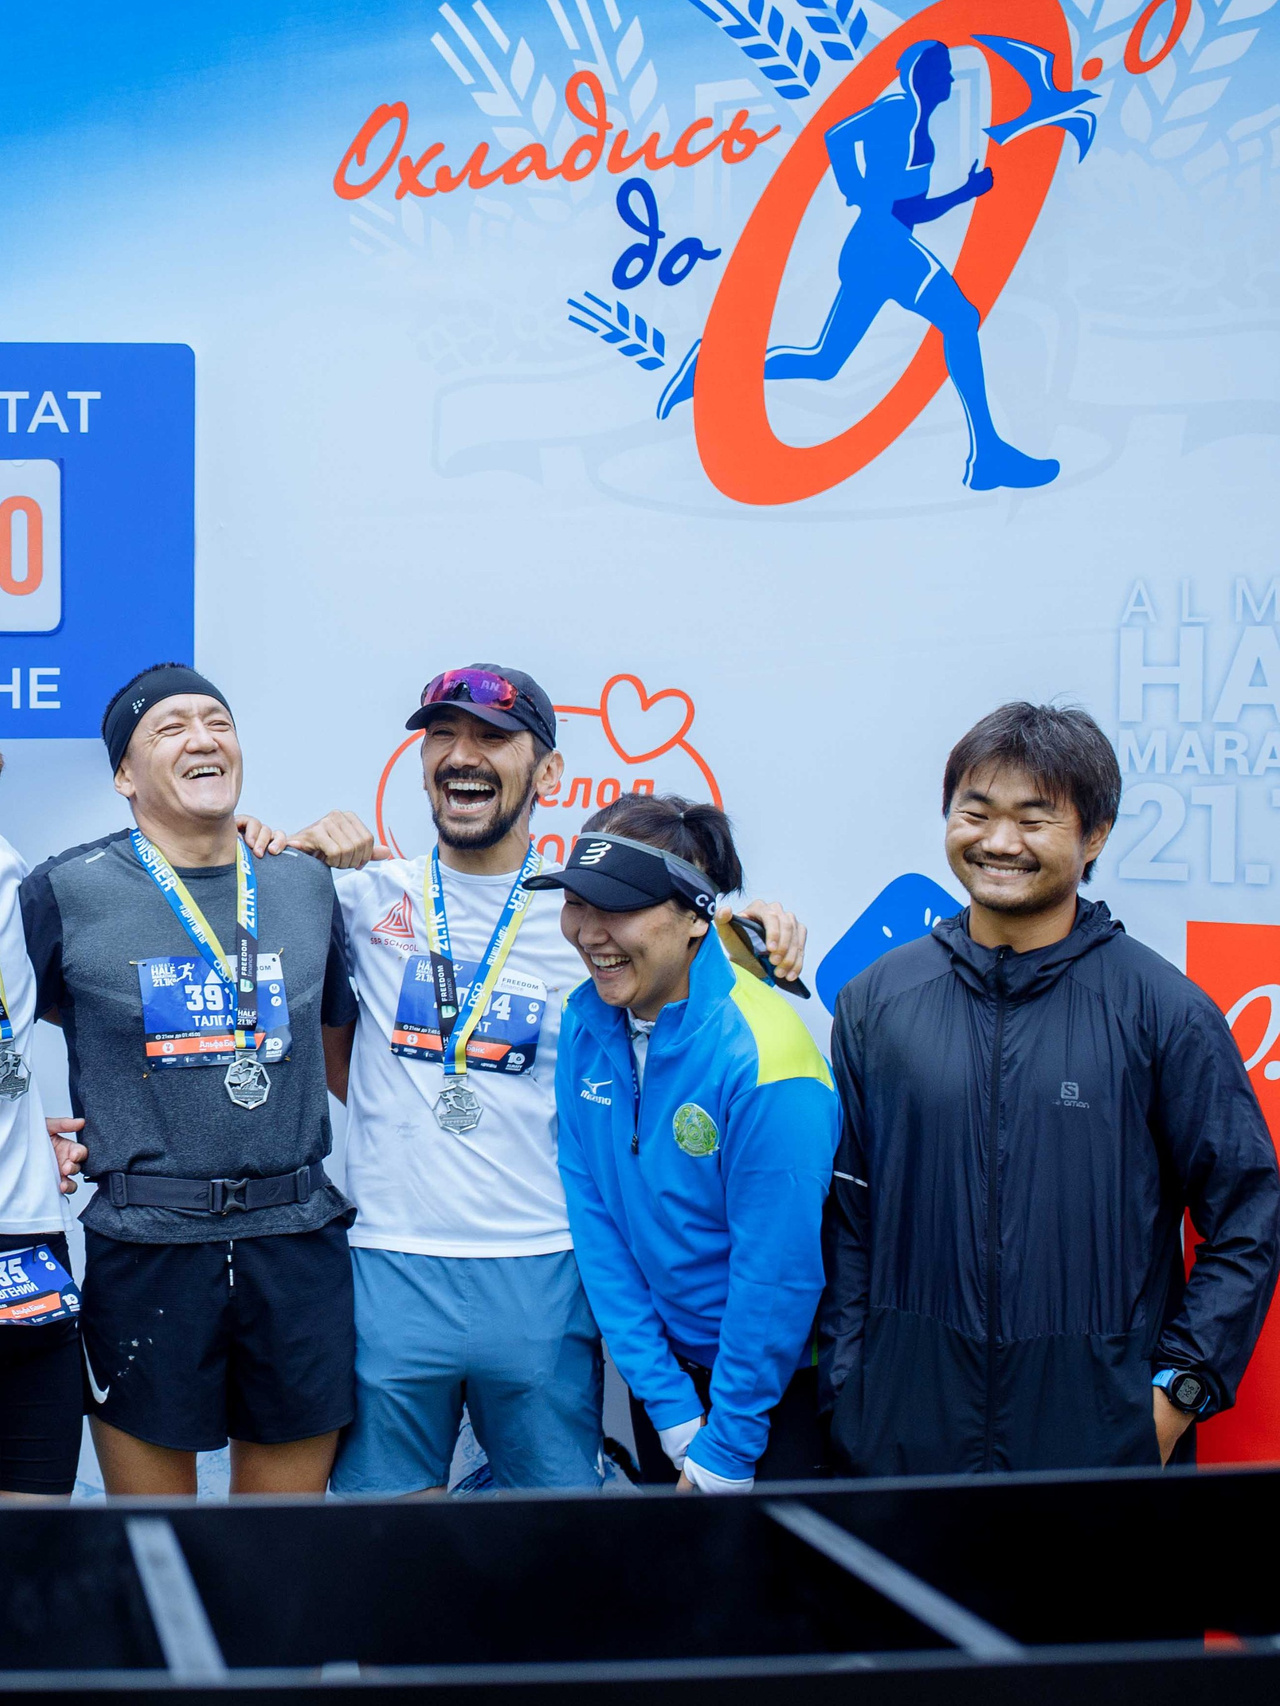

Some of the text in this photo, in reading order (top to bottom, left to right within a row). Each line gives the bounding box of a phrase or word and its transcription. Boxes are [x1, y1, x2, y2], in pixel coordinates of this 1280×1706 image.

[333, 70, 781, 200] Охладись
[612, 177, 722, 289] до
[1119, 782, 1280, 884] 21.
[132, 831, 178, 893] FINISHER
[370, 937, 419, 951] SBR SCHOOL
[151, 966, 175, 976] HALF
[436, 965, 448, 1002] FREEDOM
[502, 977, 539, 990] FREEDOM
